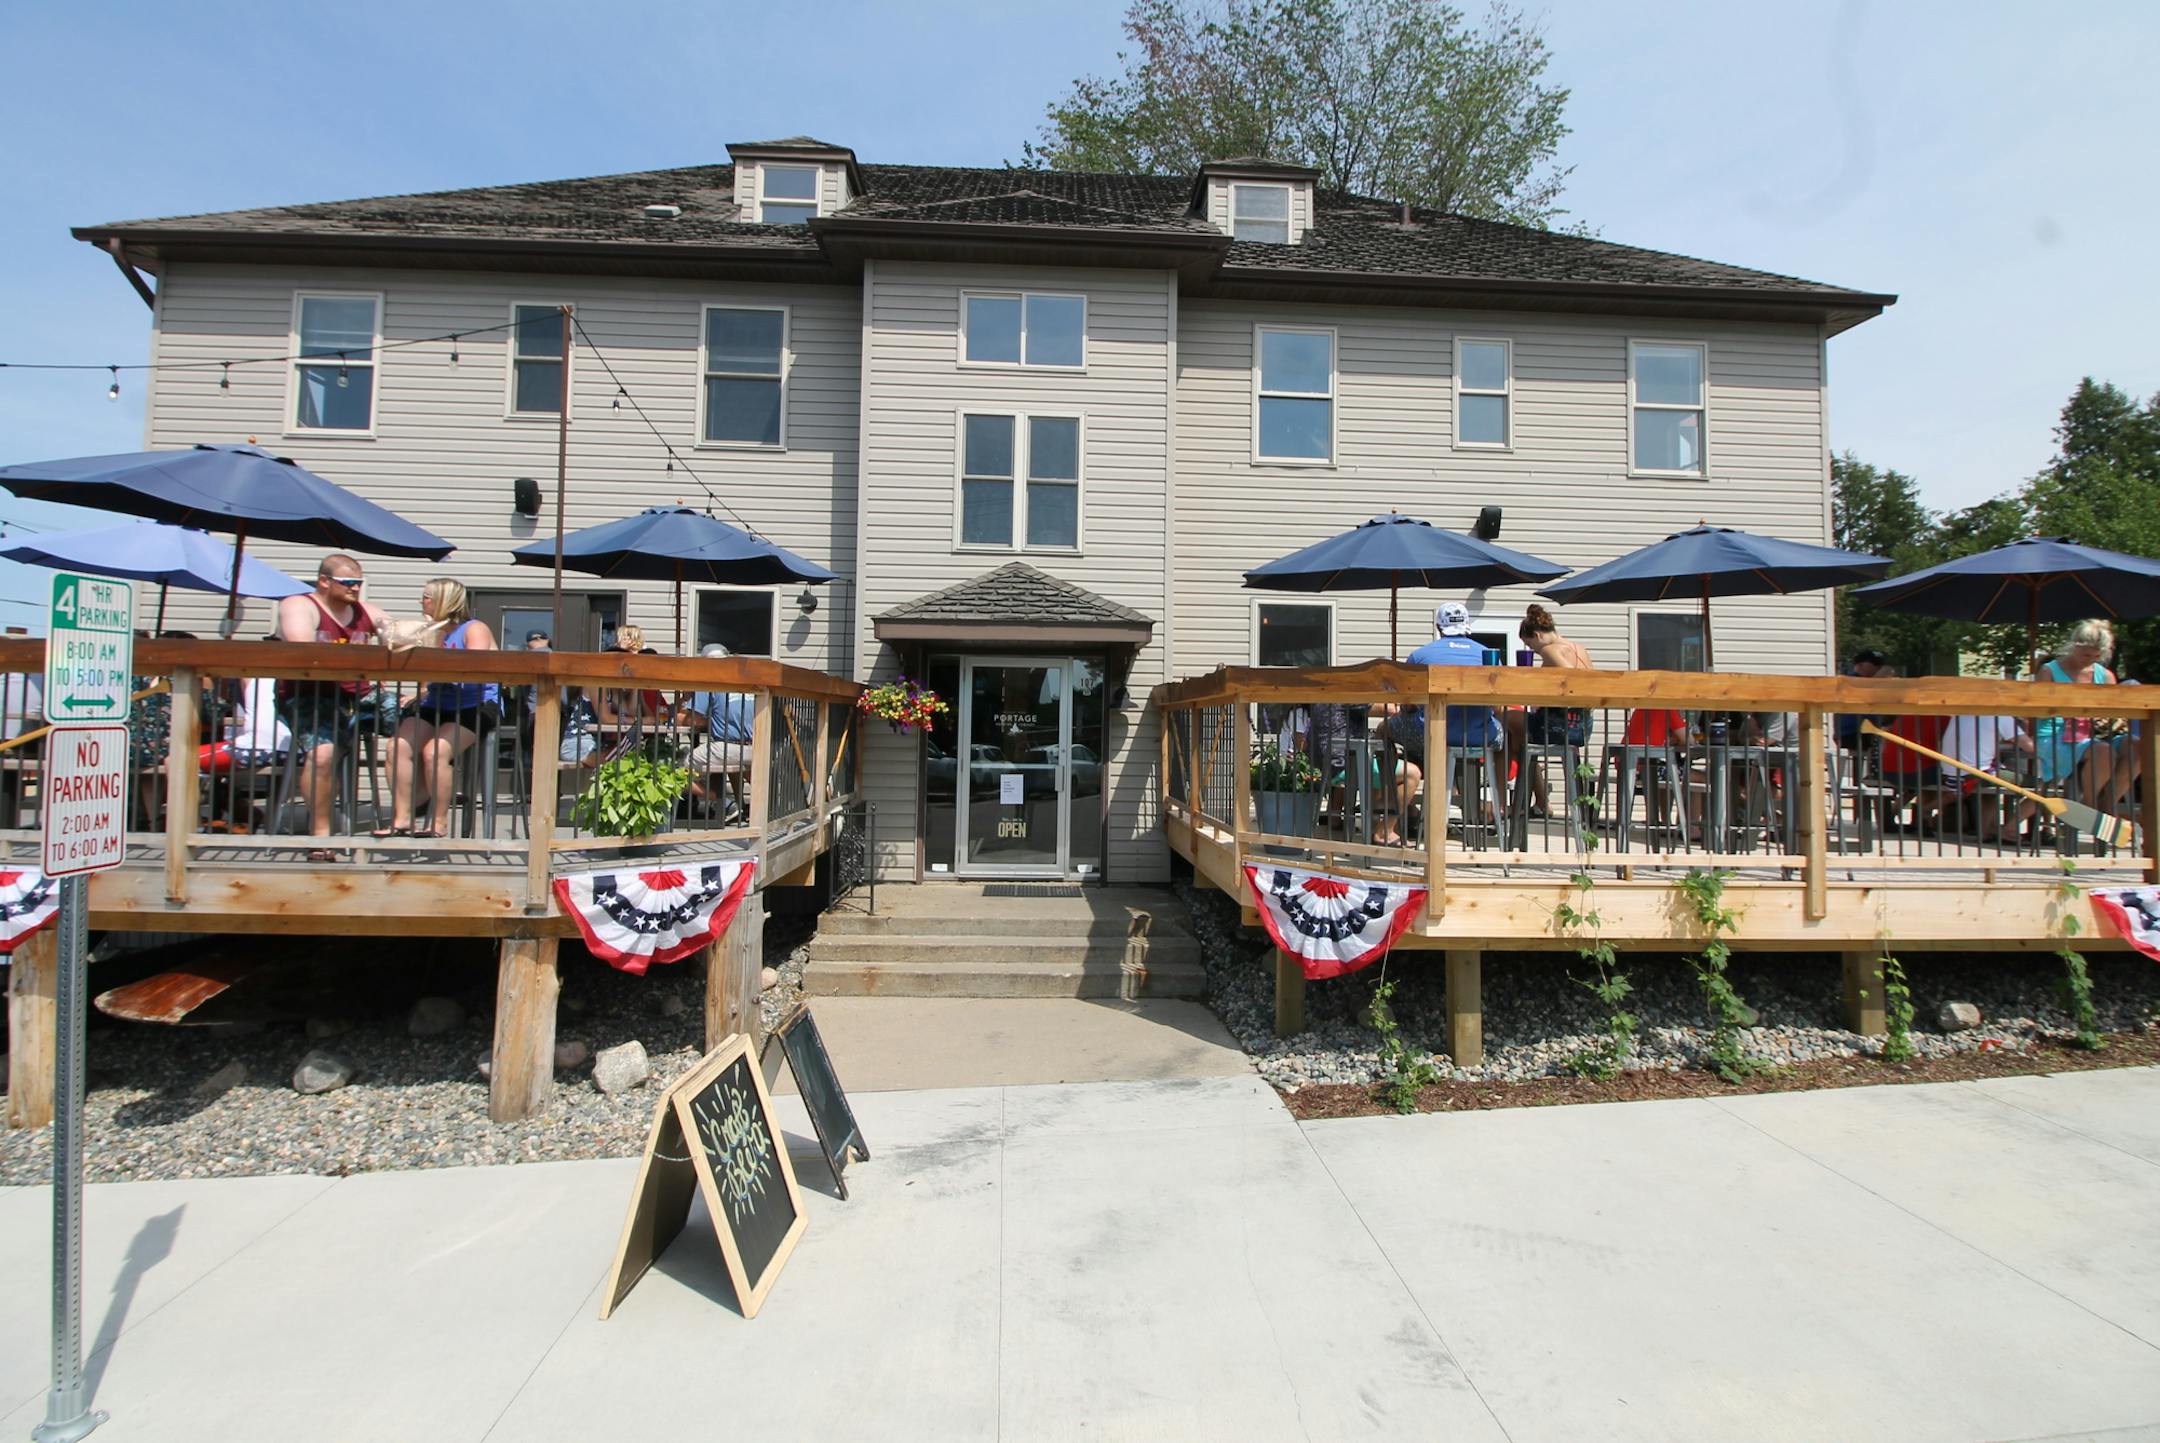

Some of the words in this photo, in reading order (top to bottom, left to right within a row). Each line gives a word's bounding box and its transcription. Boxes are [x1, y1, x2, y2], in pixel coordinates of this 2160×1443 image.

[55, 585, 76, 621] 4
[96, 586, 112, 603] HR
[80, 606, 128, 627] PARKING
[67, 641, 95, 659] 8:00
[100, 643, 116, 660] AM
[56, 667, 70, 686] TO
[77, 668, 104, 686] 5:00
[109, 670, 124, 686] PM
[993, 714, 1037, 723] PORTAGE
[77, 741, 99, 768] NO
[53, 773, 120, 803] PARKING
[62, 814, 90, 834] 2:00
[94, 812, 109, 830] AM
[998, 821, 1026, 838] OPEN
[52, 842, 65, 861] TO
[70, 838, 97, 859] 6:00
[102, 835, 118, 853] AM
